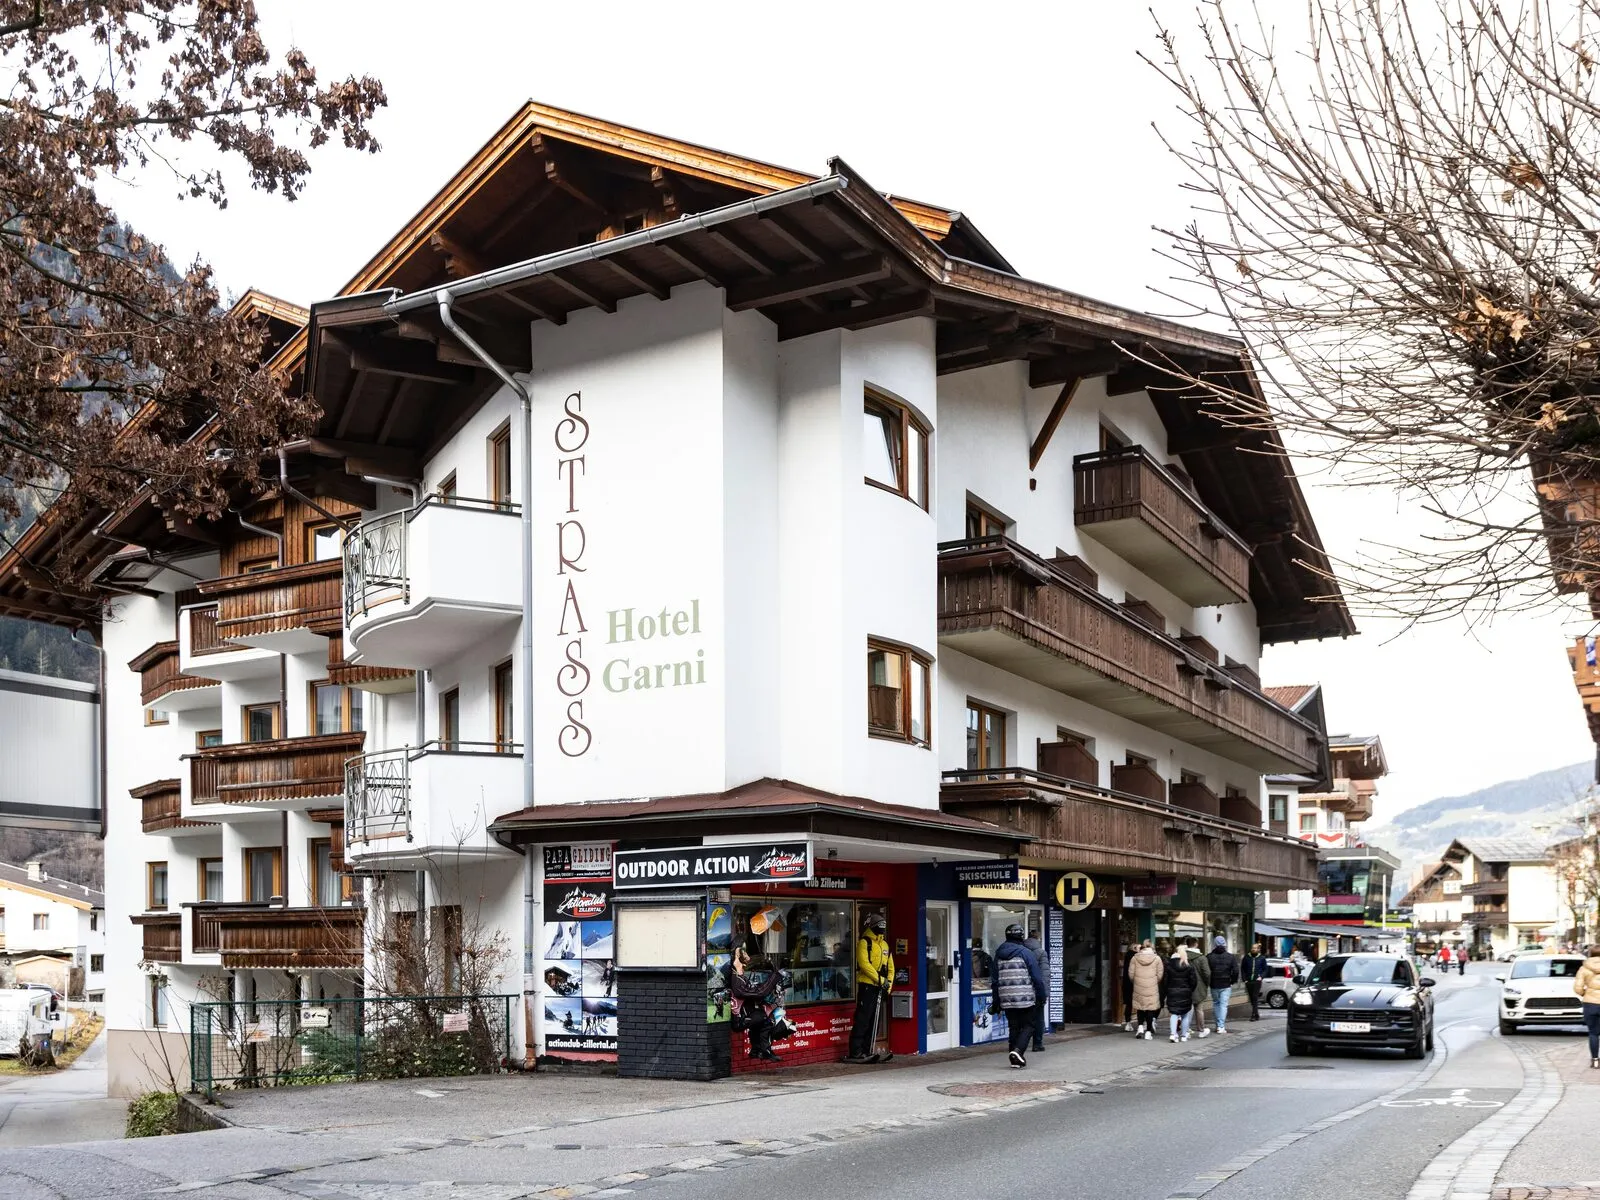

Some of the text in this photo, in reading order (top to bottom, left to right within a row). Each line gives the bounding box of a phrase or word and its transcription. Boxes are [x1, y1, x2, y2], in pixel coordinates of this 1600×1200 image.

[555, 390, 592, 758] STRASS
[605, 598, 702, 645] Hotel
[603, 649, 707, 694] Garni
[618, 855, 750, 879] OUTDOOR ACTION
[755, 852, 806, 872] Actionclub
[820, 877, 847, 889] Zillertal
[959, 870, 1011, 881] SKISCHULE
[558, 892, 607, 911] Actionclub
[1063, 877, 1088, 905] H
[548, 1038, 618, 1050] actionclub-zillertal.at
